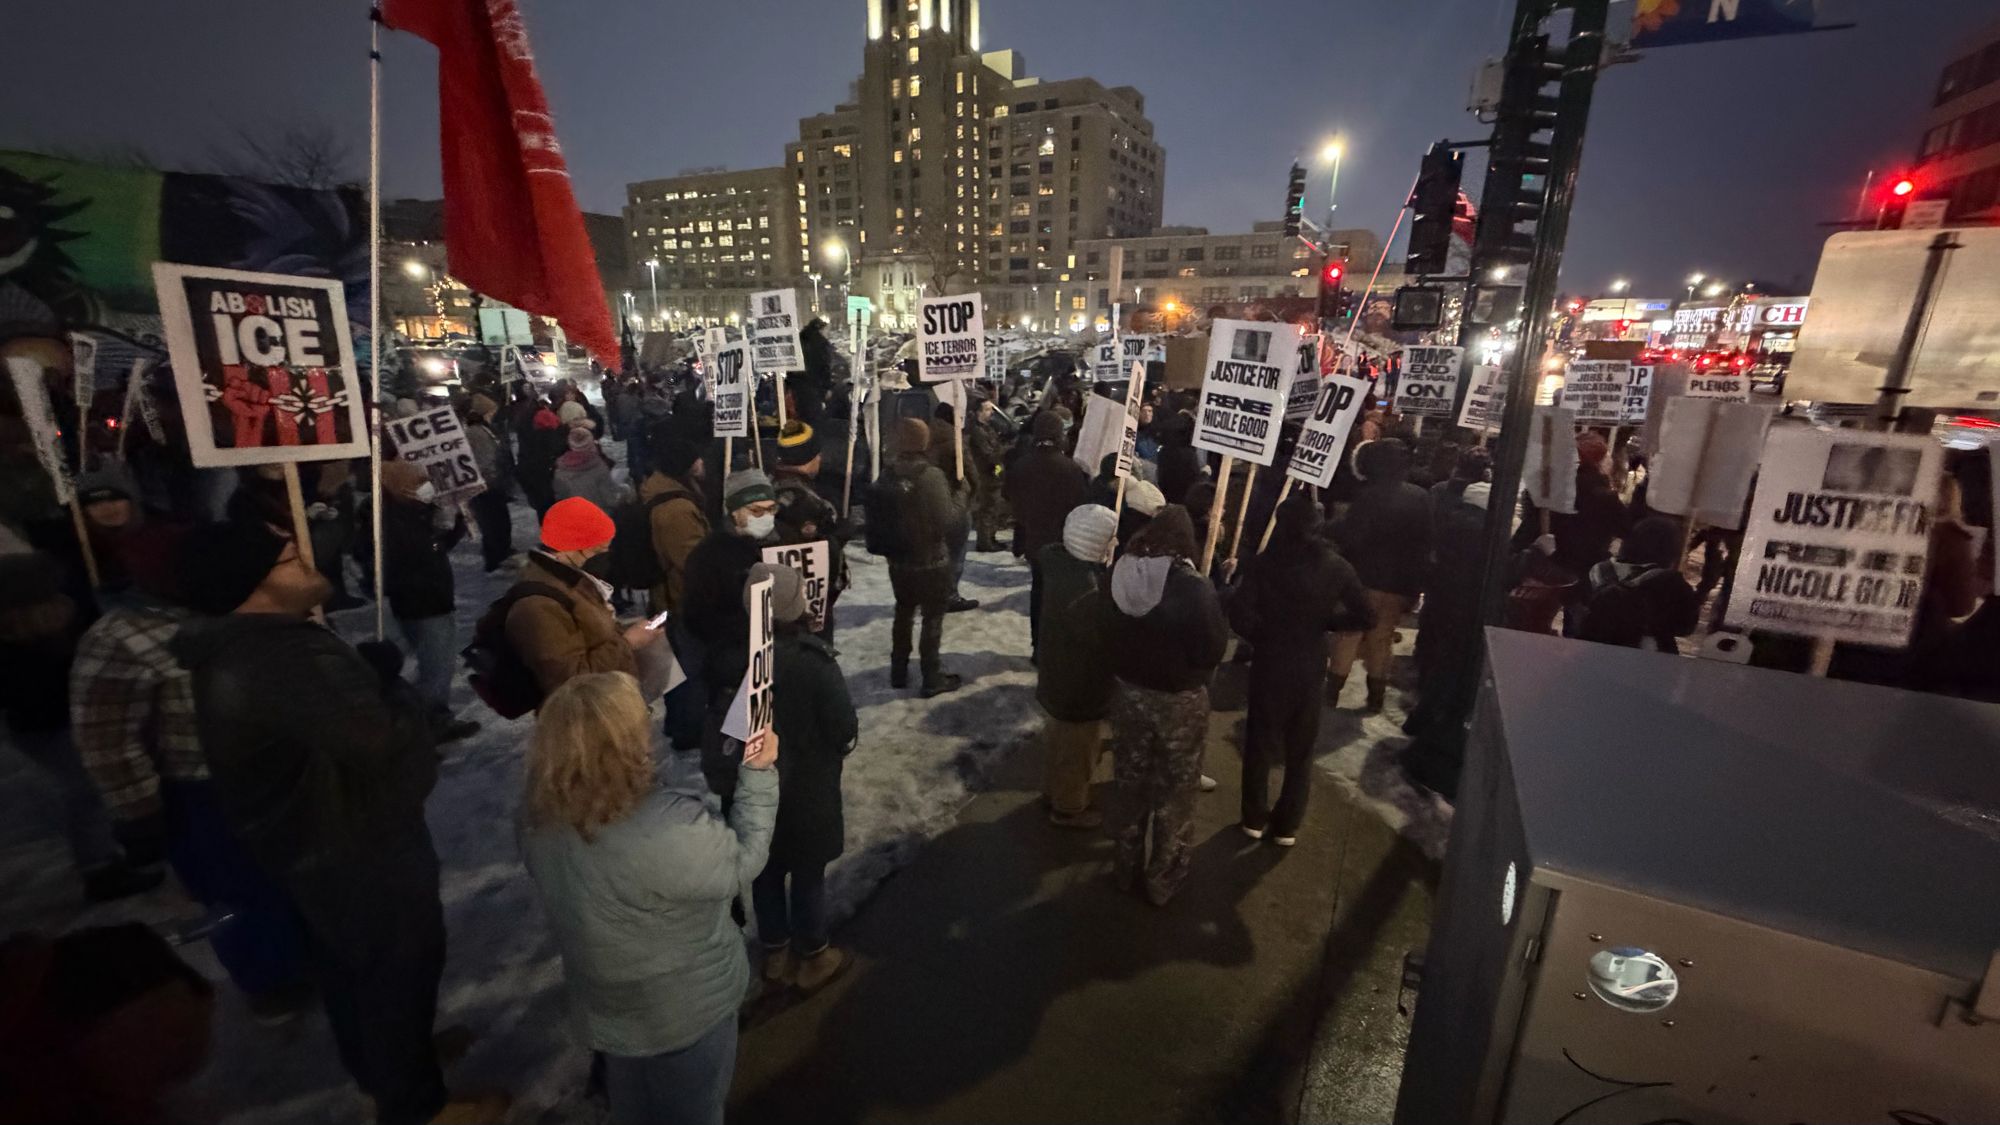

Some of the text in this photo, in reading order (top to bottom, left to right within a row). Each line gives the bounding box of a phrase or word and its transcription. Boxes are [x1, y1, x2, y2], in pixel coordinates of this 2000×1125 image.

[210, 291, 317, 319] ABOLISH
[1761, 306, 1804, 323] CH
[924, 301, 975, 336] STOP
[212, 314, 326, 367] ICE
[925, 338, 977, 355] ICE TERROR
[1124, 338, 1146, 356] STOP
[716, 347, 744, 387] STOP
[926, 354, 978, 366] NOW!
[1297, 342, 1316, 375] OP
[1409, 364, 1451, 375] END
[1210, 360, 1281, 391] JUSTICE FOR
[1566, 383, 1623, 392] EDUCATION
[1577, 373, 1614, 382] JOBS &
[1313, 381, 1355, 425] OP
[1405, 383, 1446, 399] ON
[1625, 385, 1649, 397] TING
[1206, 391, 1274, 418] RENEE
[391, 410, 458, 444] ICE
[1202, 407, 1270, 441] NICOLE GOOD
[404, 437, 465, 461] OUT OF
[806, 577, 825, 601] OF
[761, 587, 772, 645] IC
